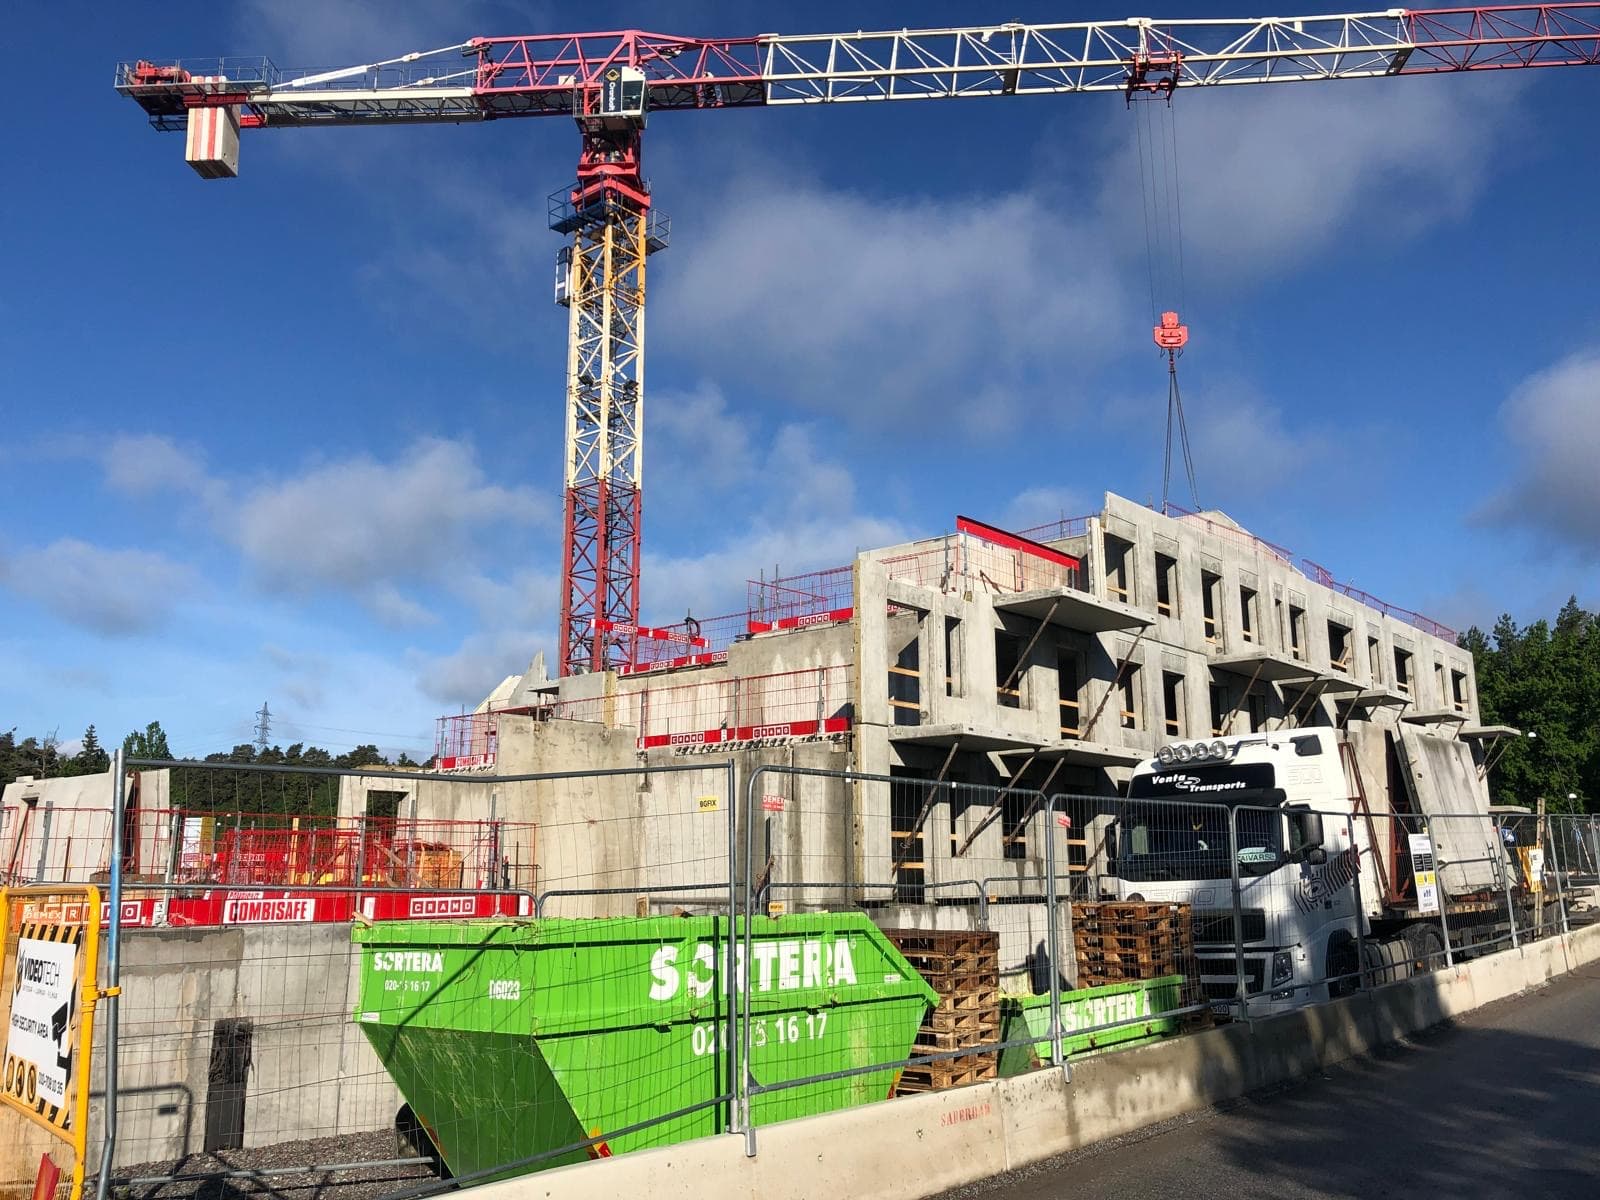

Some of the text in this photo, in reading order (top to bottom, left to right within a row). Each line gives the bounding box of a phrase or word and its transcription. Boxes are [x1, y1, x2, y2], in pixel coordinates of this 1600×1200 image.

[1151, 774, 1187, 785] Venta
[1189, 781, 1246, 792] Transports
[229, 901, 308, 922] COMBISAFE
[412, 901, 474, 914] CRAMO
[374, 951, 444, 972] SORTERA
[649, 938, 858, 1001] SORTERA
[25, 957, 61, 988] VIDEOTECH
[774, 1015, 800, 1044] 16
[805, 1012, 828, 1041] 17
